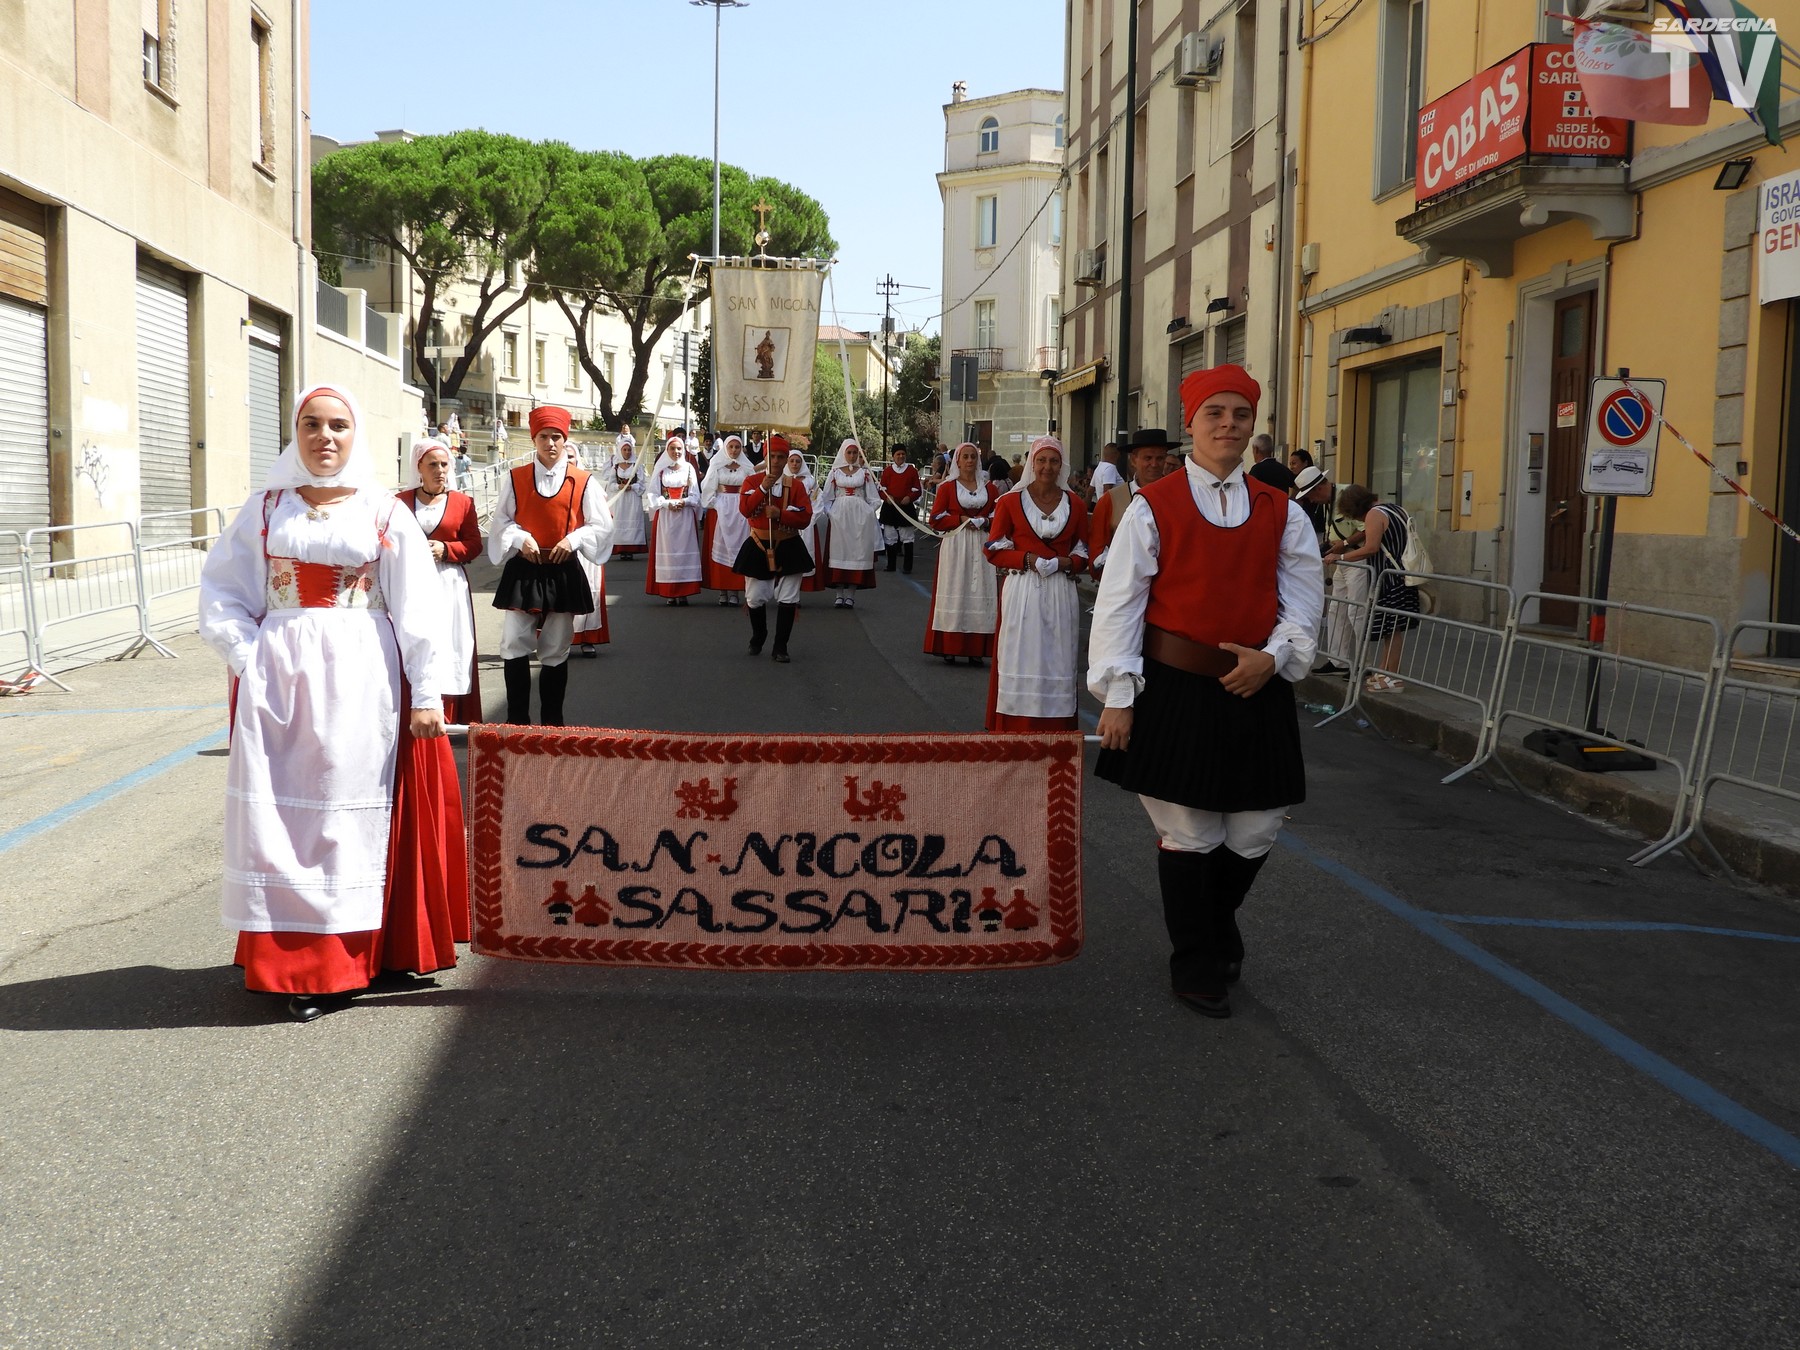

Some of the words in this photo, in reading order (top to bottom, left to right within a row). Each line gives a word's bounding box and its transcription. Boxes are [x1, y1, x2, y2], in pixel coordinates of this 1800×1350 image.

[1424, 64, 1520, 188] COBAS
[1500, 115, 1520, 134] COBAS
[1556, 123, 1588, 133] SEDE
[1592, 123, 1604, 133] D
[1547, 134, 1611, 149] NUORO
[1455, 164, 1468, 180] SEDE
[1469, 161, 1477, 174] DI
[1477, 151, 1499, 168] NUORO
[728, 295, 758, 311] SAN
[770, 296, 816, 313] NICOLA
[732, 394, 790, 414] SASSARI
[516, 823, 708, 874] SAN
[719, 828, 1027, 879] NICOLA
[613, 885, 972, 934] SASSARI
